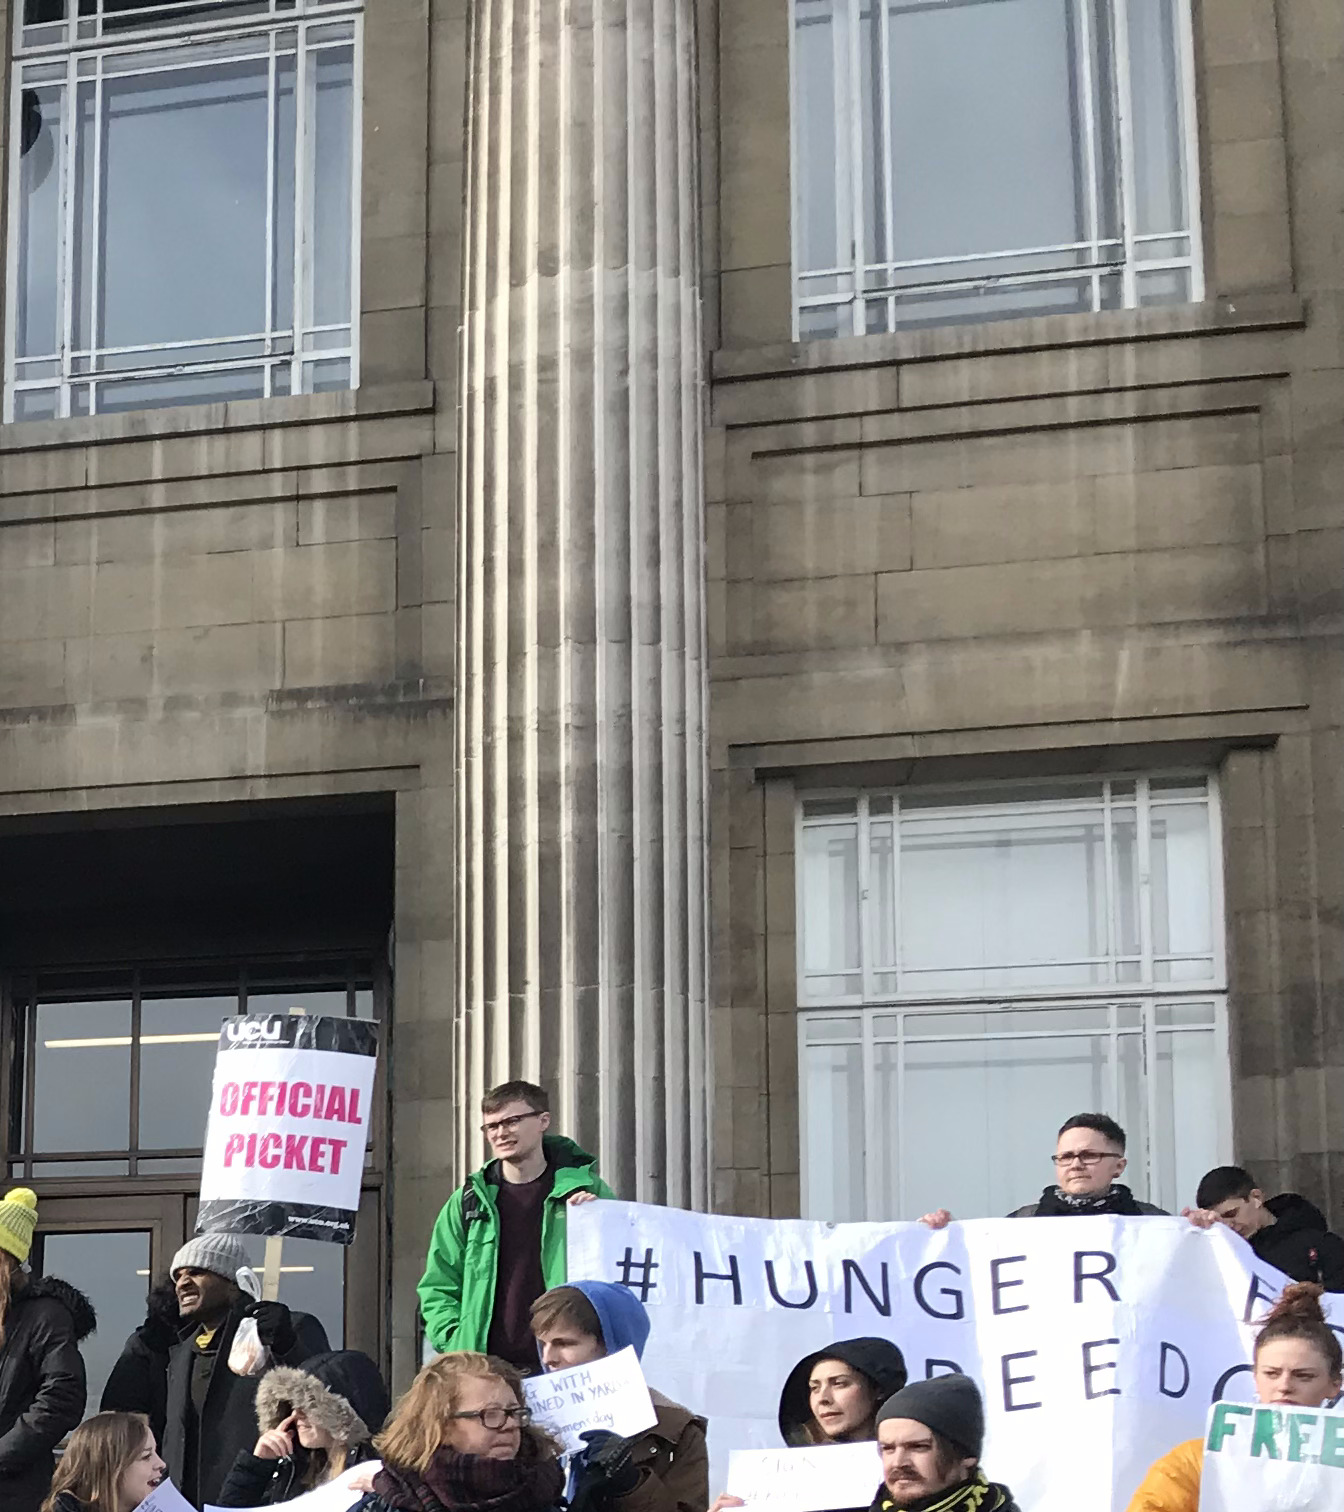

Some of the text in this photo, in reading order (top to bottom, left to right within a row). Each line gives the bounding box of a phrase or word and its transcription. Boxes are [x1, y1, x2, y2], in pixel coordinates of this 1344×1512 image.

[220, 1081, 363, 1125] OFFICIAL
[223, 1133, 348, 1175] PICKET
[615, 1246, 1123, 1321] #HUNGER
[531, 1396, 565, 1414] INED
[571, 1391, 585, 1405] IN
[550, 1369, 592, 1393] WITH
[1207, 1403, 1344, 1468] FREE
